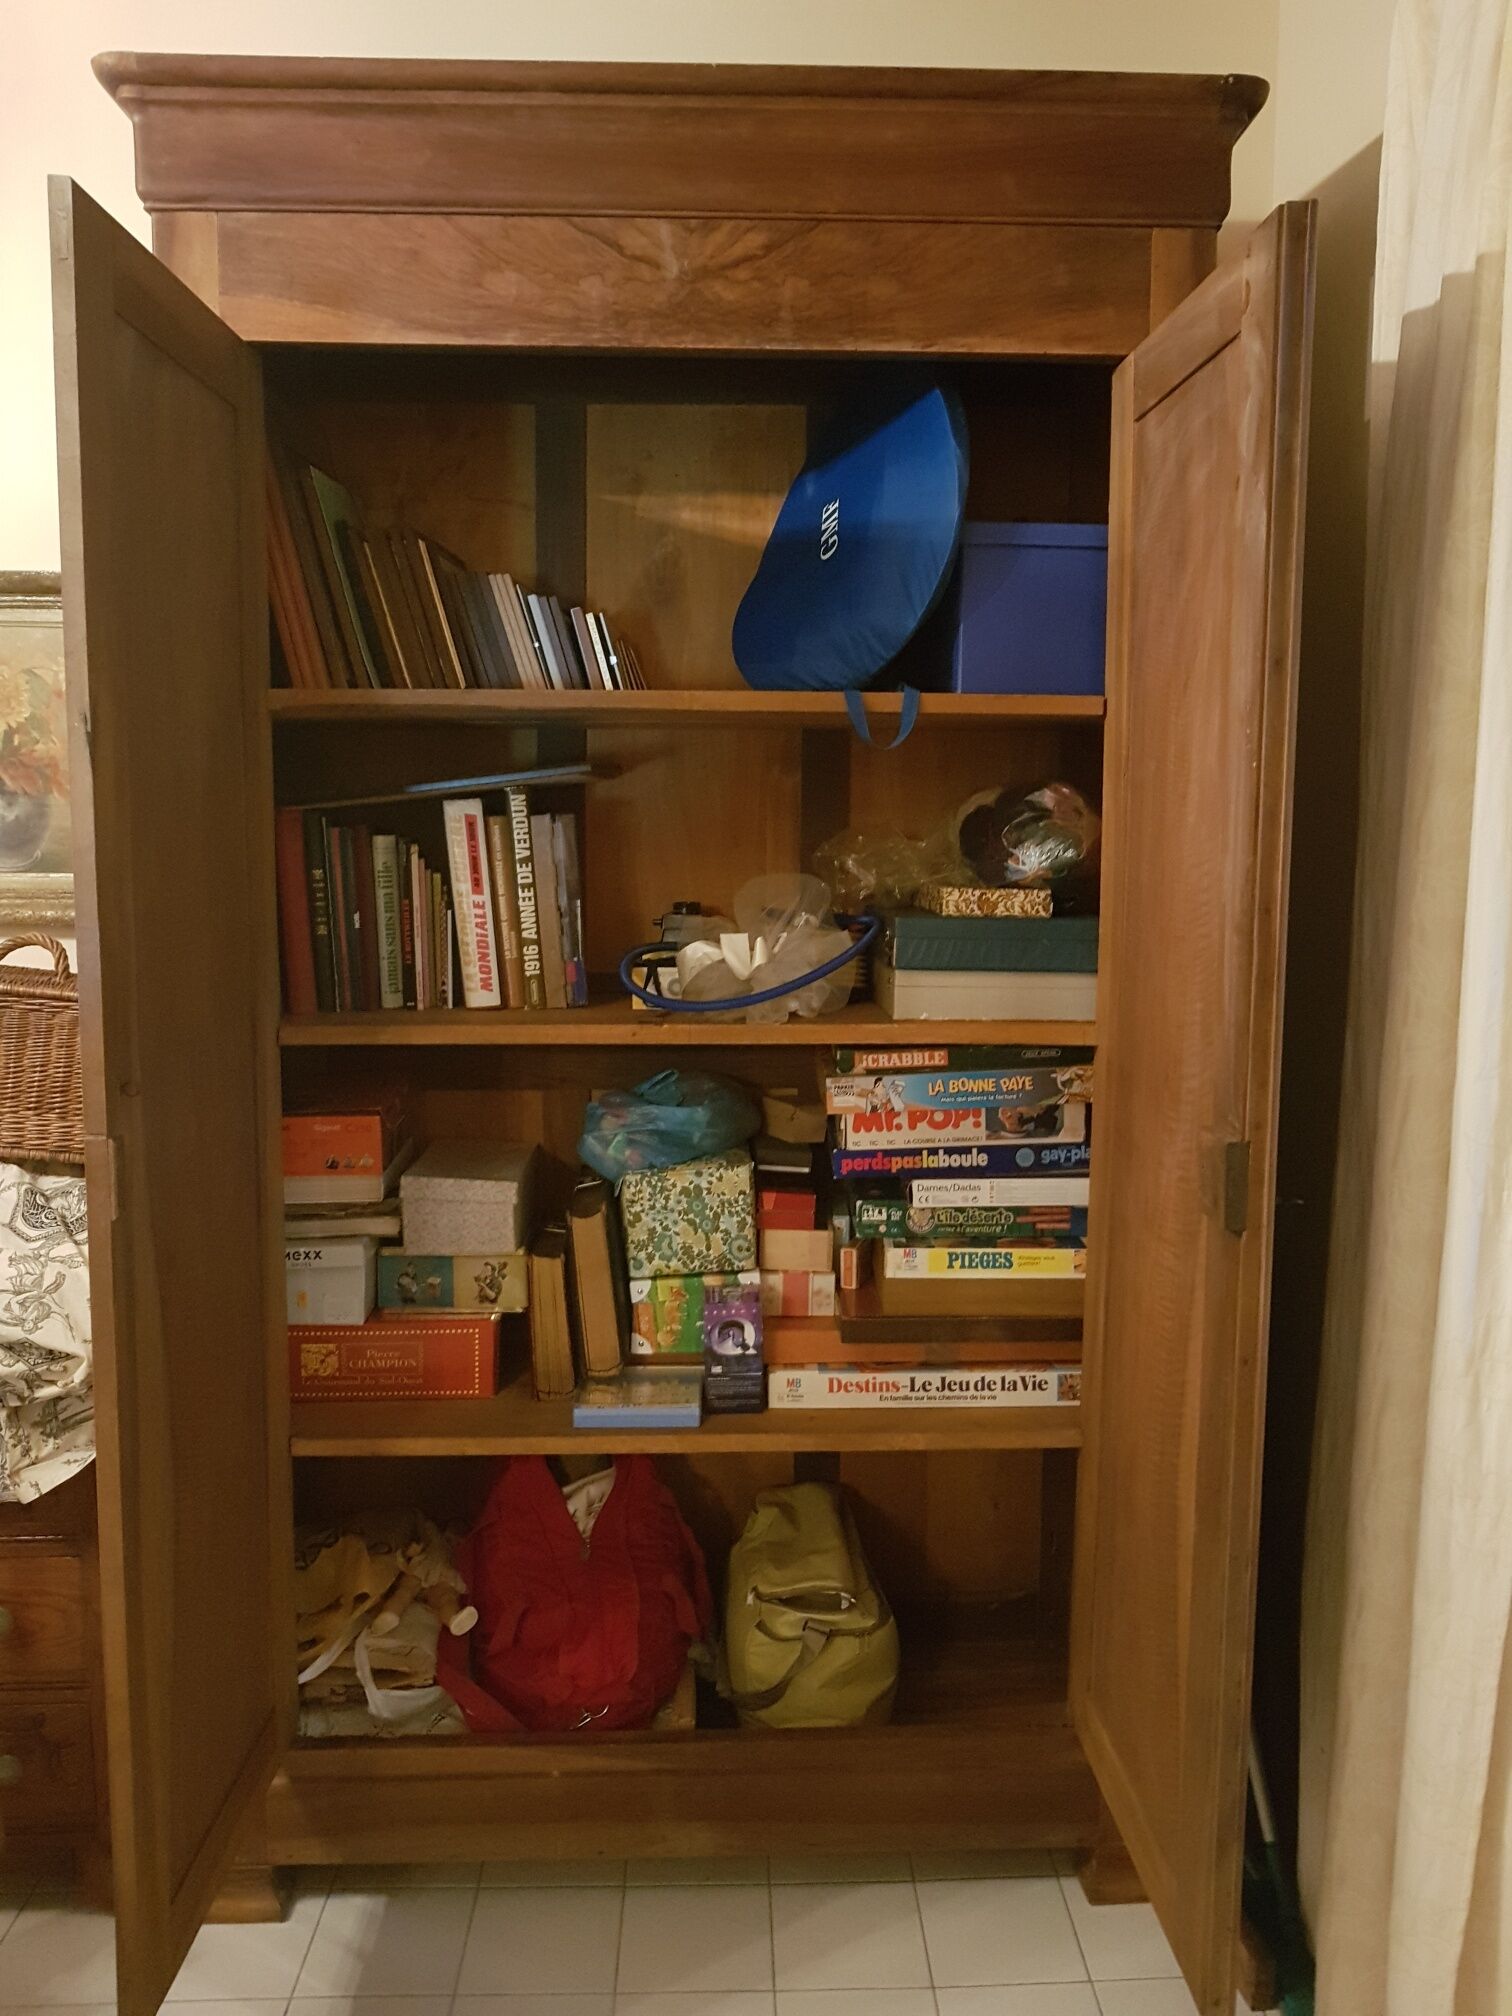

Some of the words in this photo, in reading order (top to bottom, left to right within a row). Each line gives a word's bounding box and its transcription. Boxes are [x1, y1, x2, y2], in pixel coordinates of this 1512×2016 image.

[820, 497, 840, 561] GMF
[511, 794, 530, 859] VERDUN
[516, 862, 532, 884] DE
[383, 893, 395, 914] ma
[518, 887, 537, 939] ANNÉE
[385, 915, 396, 948] sans
[472, 900, 493, 993] MONDIALE
[522, 945, 540, 977] 1916
[927, 1078, 945, 1096] LA
[948, 1076, 997, 1094] BONNE
[1000, 1076, 1034, 1092] PAYE
[916, 1182, 982, 1193] Dames/Dadas
[903, 1248, 918, 1259] MB
[947, 1251, 1014, 1270] PIEGES
[349, 1359, 417, 1368] CHAMPION
[786, 1378, 801, 1389] MB
[935, 1376, 977, 1392] Jeu
[978, 1376, 997, 1392] de
[1000, 1376, 1019, 1391] la
[1019, 1375, 1049, 1391] Vie
